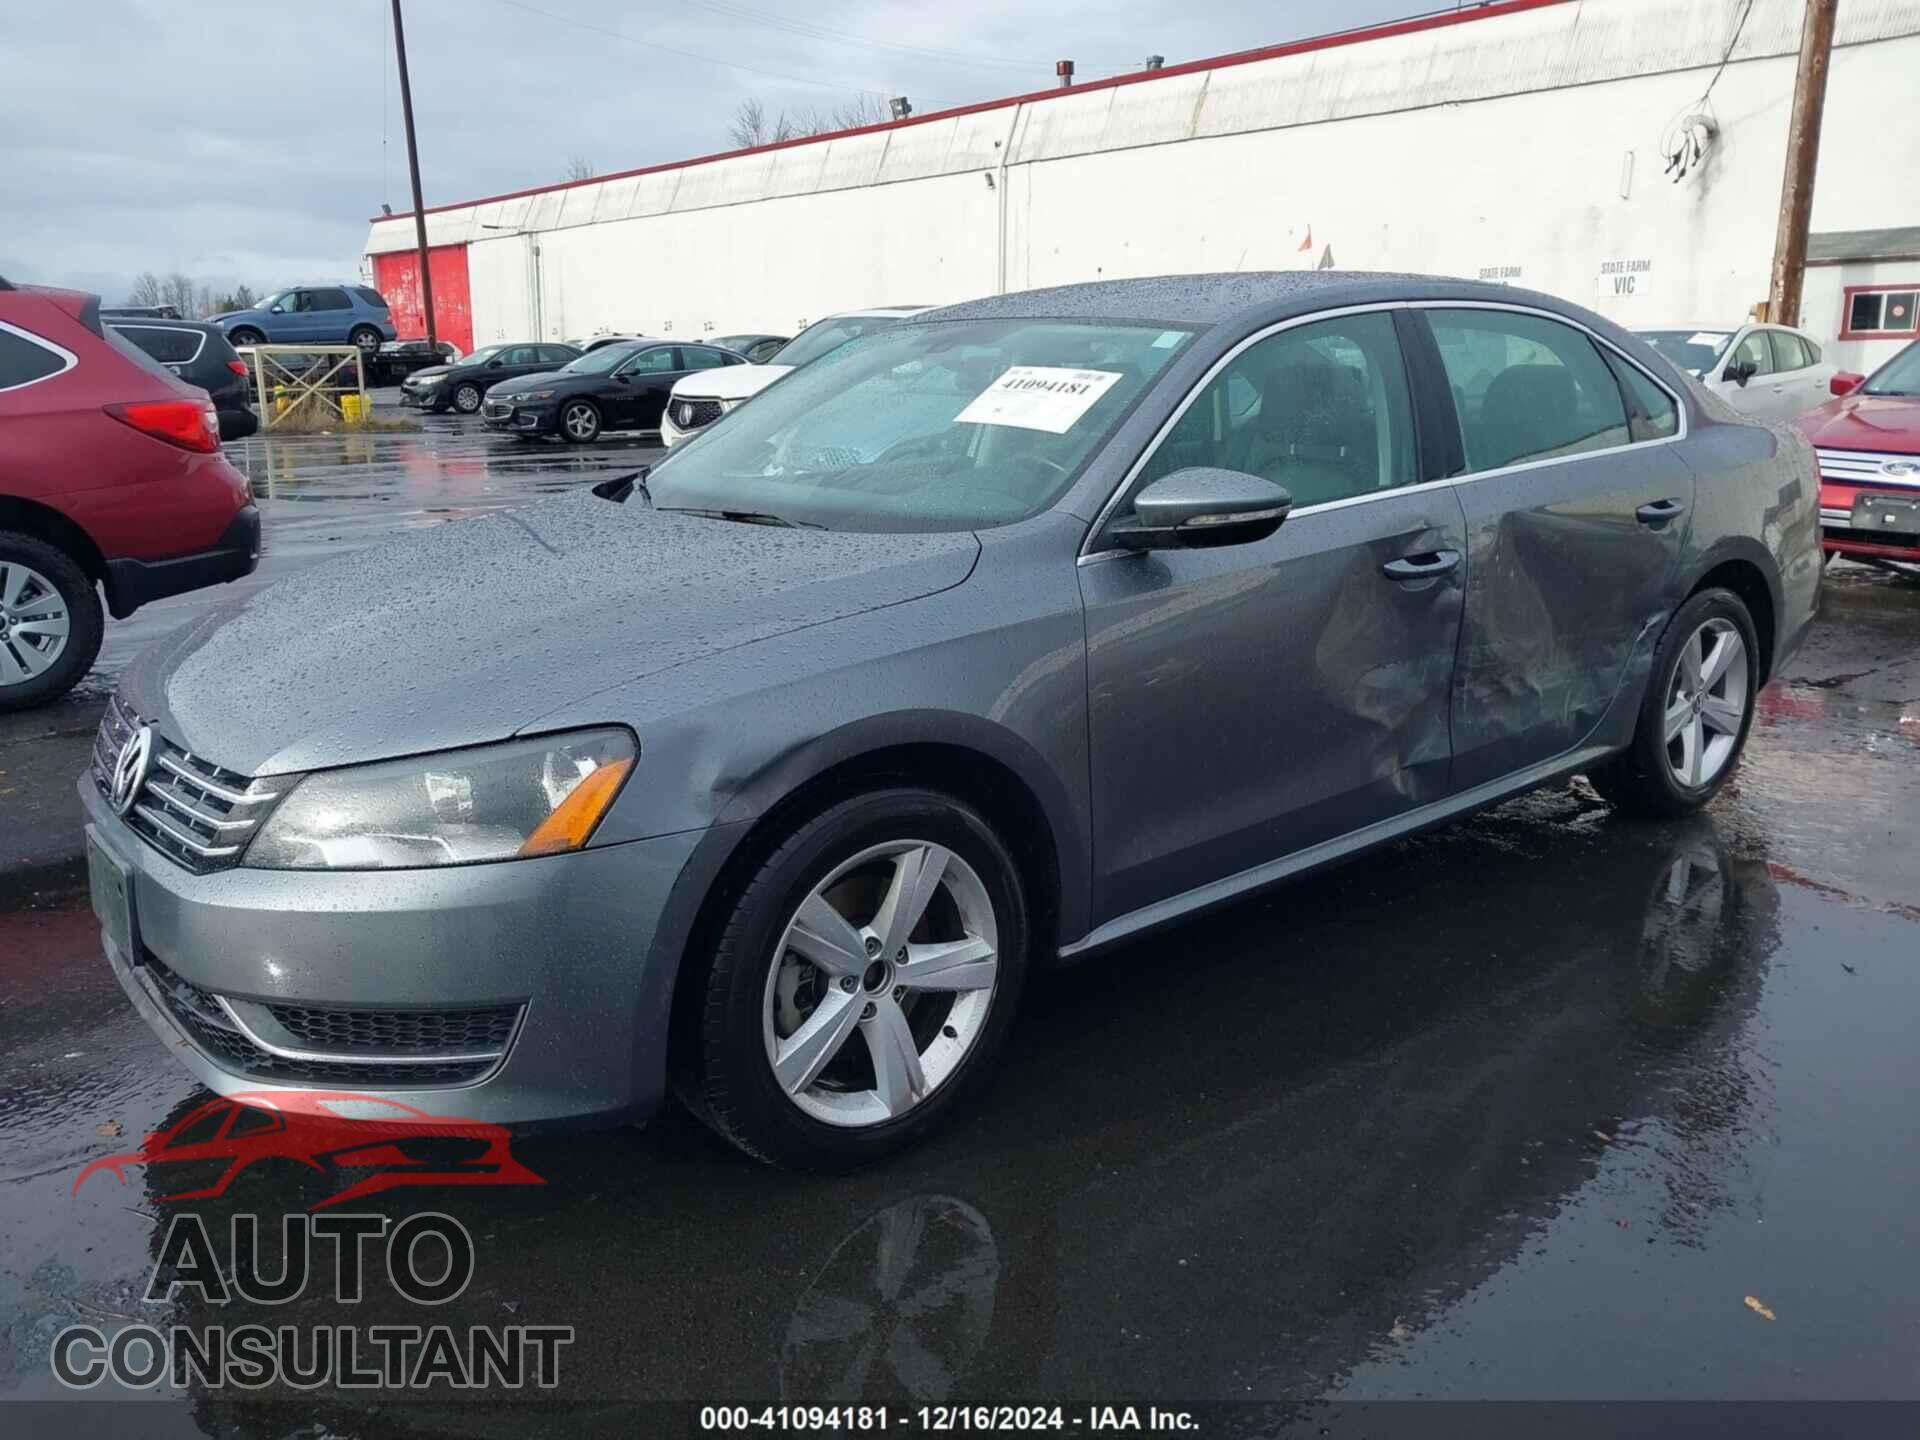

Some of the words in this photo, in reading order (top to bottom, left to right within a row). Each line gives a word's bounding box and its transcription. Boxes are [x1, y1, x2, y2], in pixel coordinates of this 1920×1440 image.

[1479, 267, 1498, 280] STATE
[1500, 266, 1522, 278] FARM
[1601, 262, 1625, 275] STATE
[1627, 260, 1650, 272] FARM
[1614, 276, 1636, 294] VIC
[1002, 379, 1091, 395] 41094181
